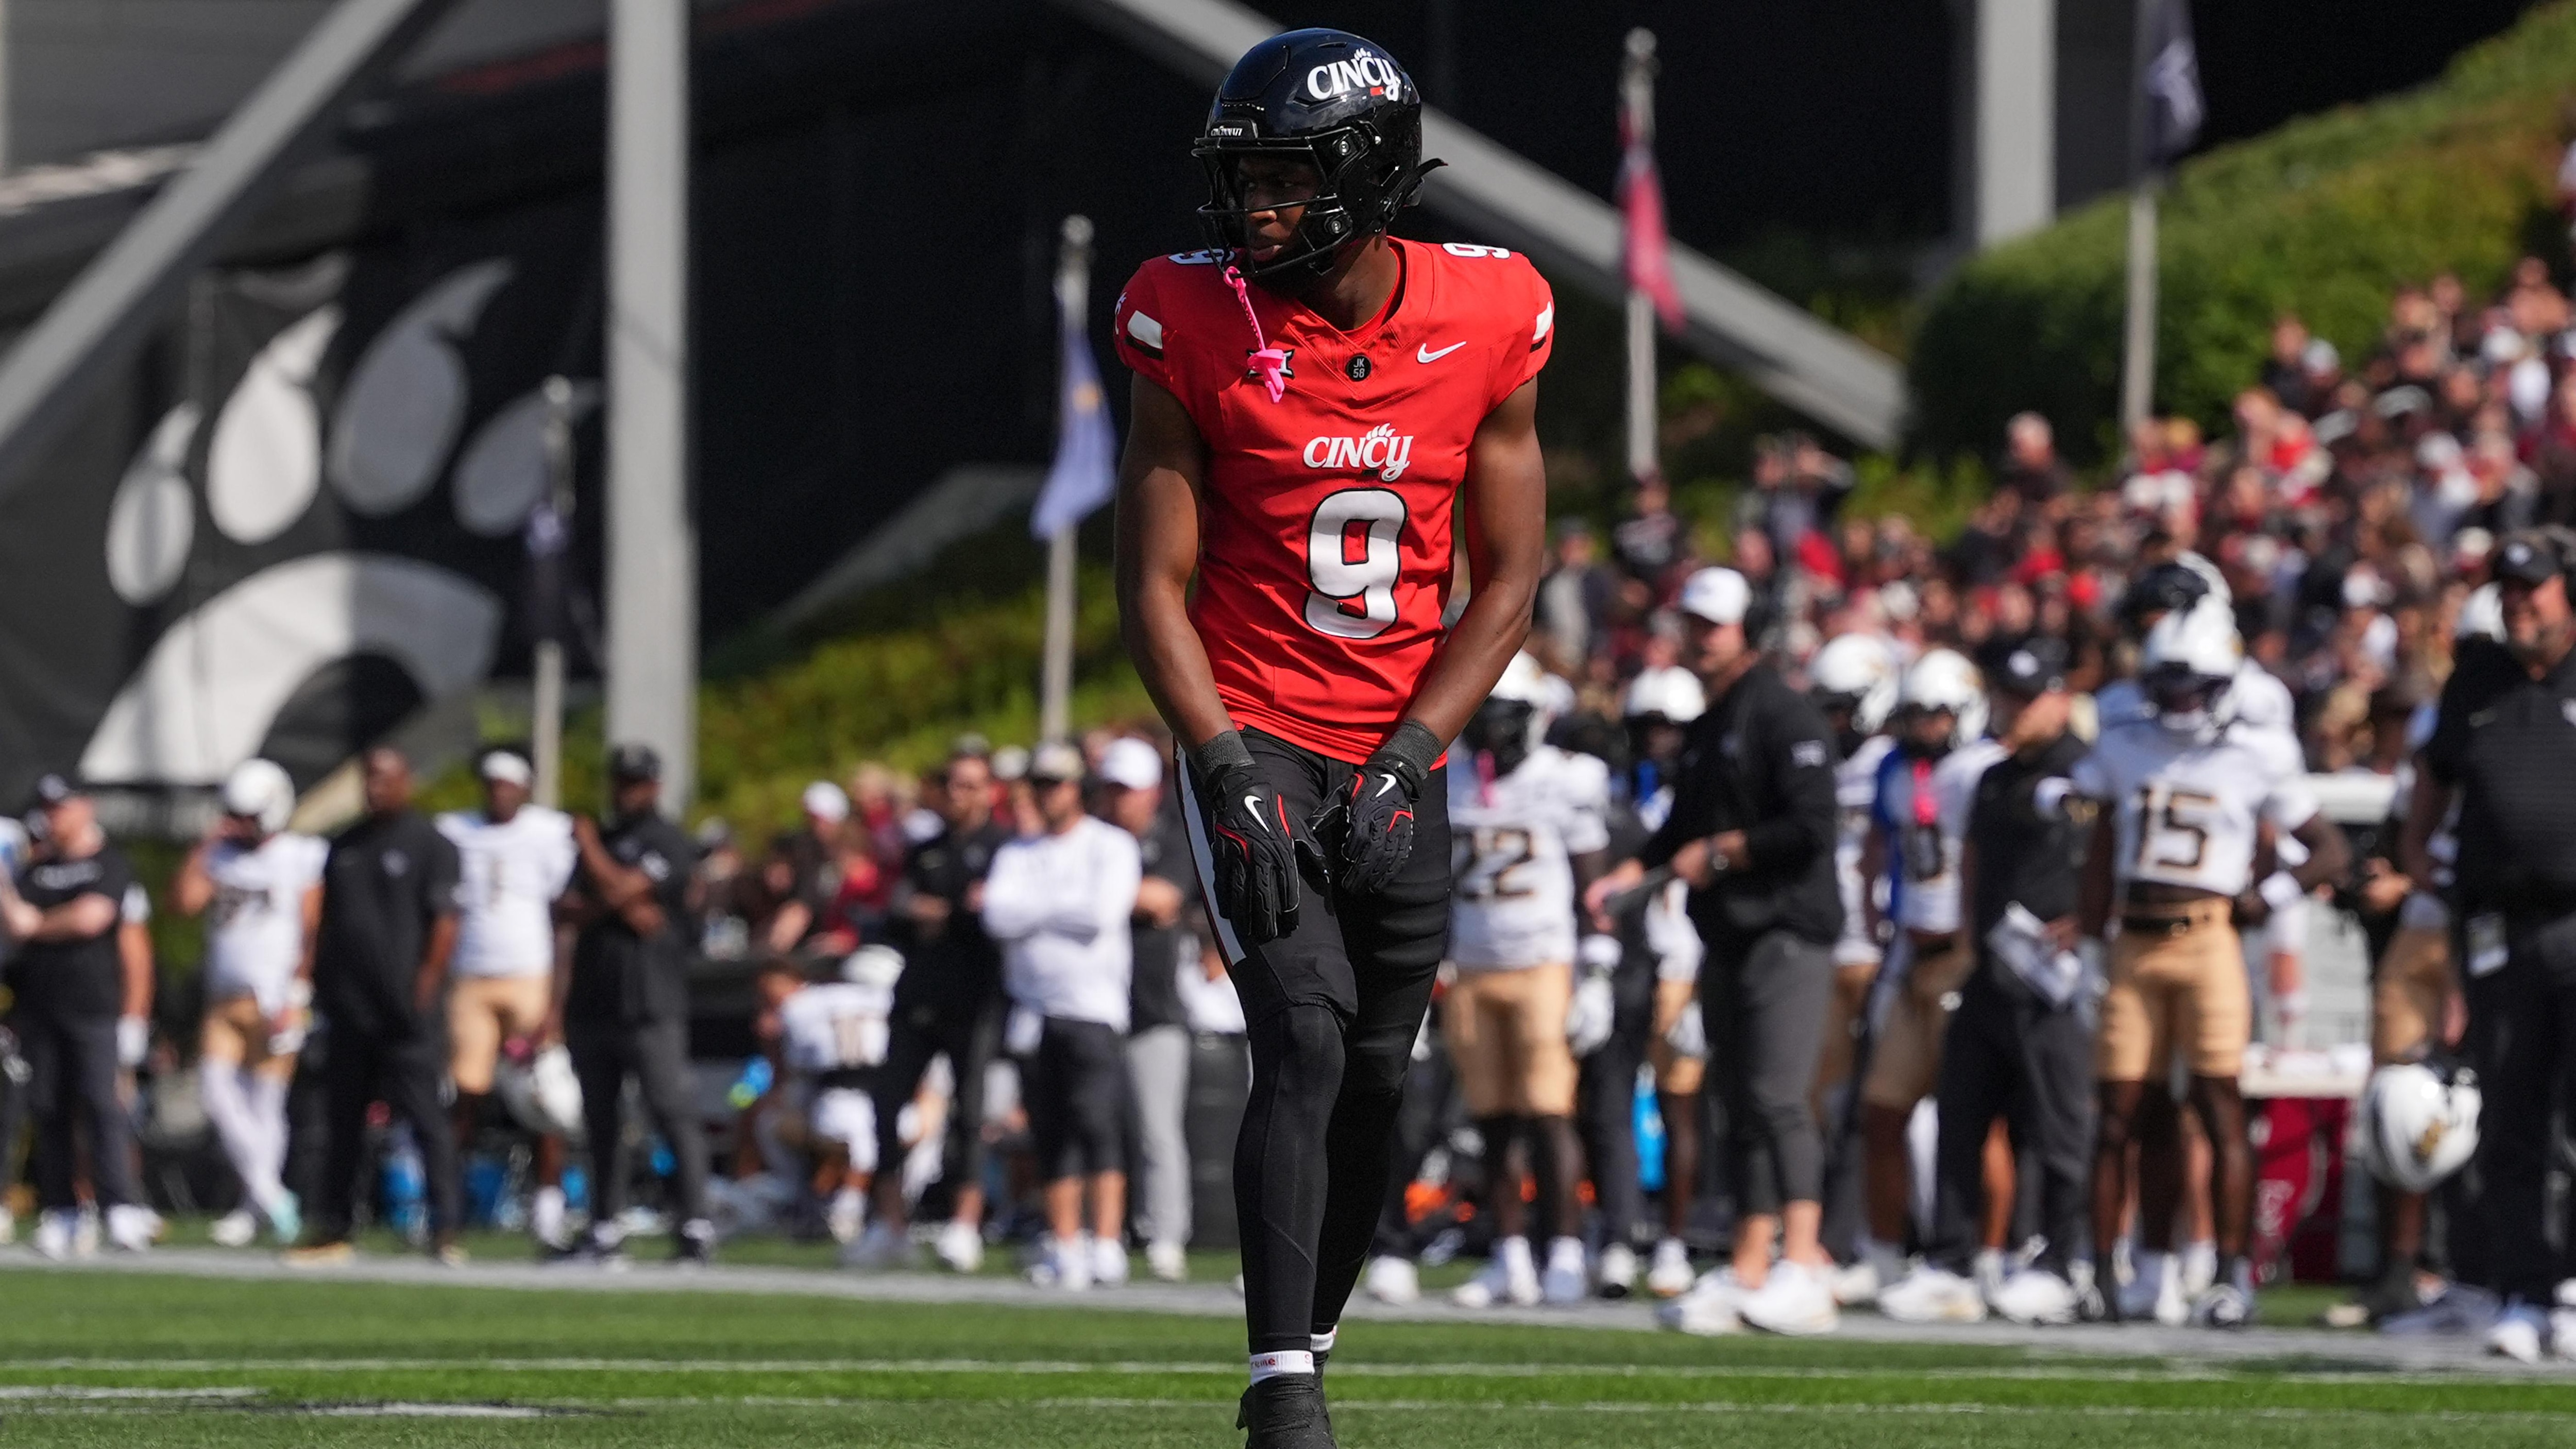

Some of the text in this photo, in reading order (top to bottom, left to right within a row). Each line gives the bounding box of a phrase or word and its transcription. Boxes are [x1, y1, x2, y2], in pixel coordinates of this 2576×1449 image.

[1307, 47, 1401, 102] CINCY
[1353, 357, 1365, 368] JK
[1353, 368, 1365, 378] 58
[1303, 422, 1414, 482] CINCY
[1302, 487, 1408, 639] 9
[2134, 783, 2218, 871] 15
